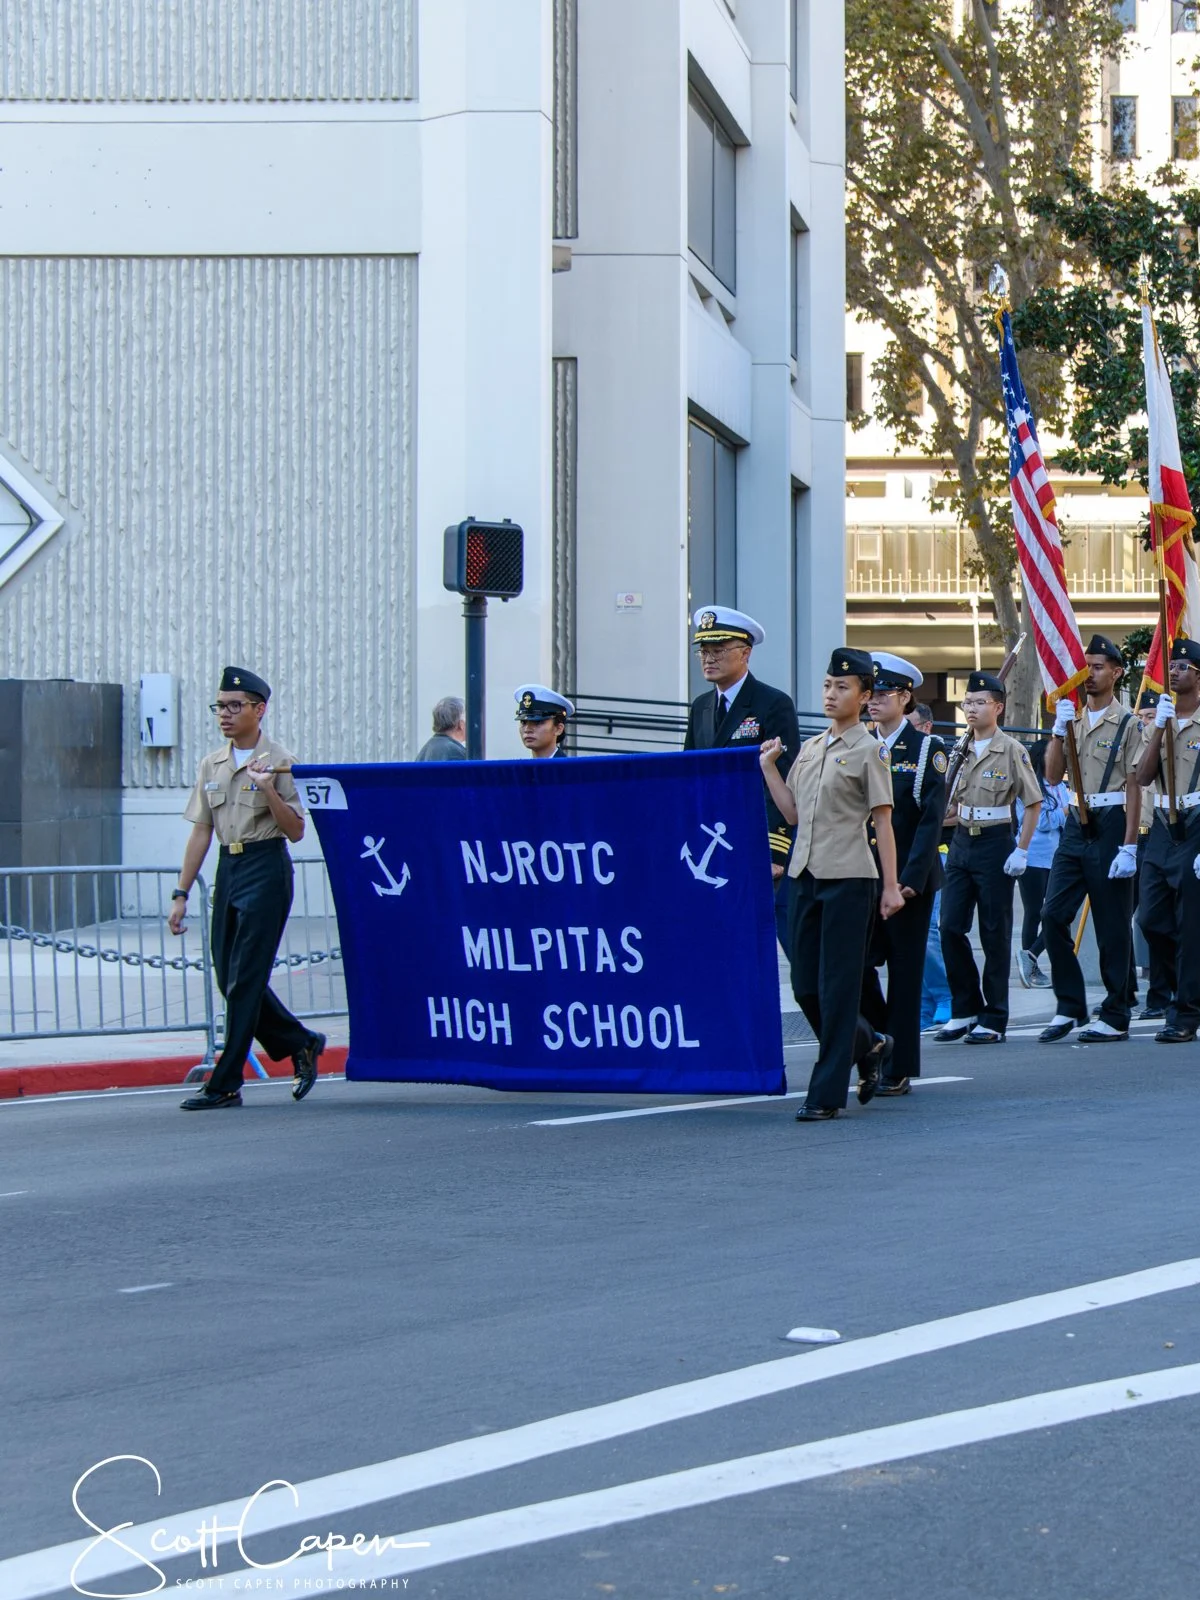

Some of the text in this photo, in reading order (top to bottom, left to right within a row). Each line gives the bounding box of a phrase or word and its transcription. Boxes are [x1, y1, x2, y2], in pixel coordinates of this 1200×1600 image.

[305, 785, 332, 805] 57
[460, 840, 615, 885] NJROTC
[461, 926, 644, 974] MILPITAS
[427, 996, 700, 1051] HIGH SCHOOL
